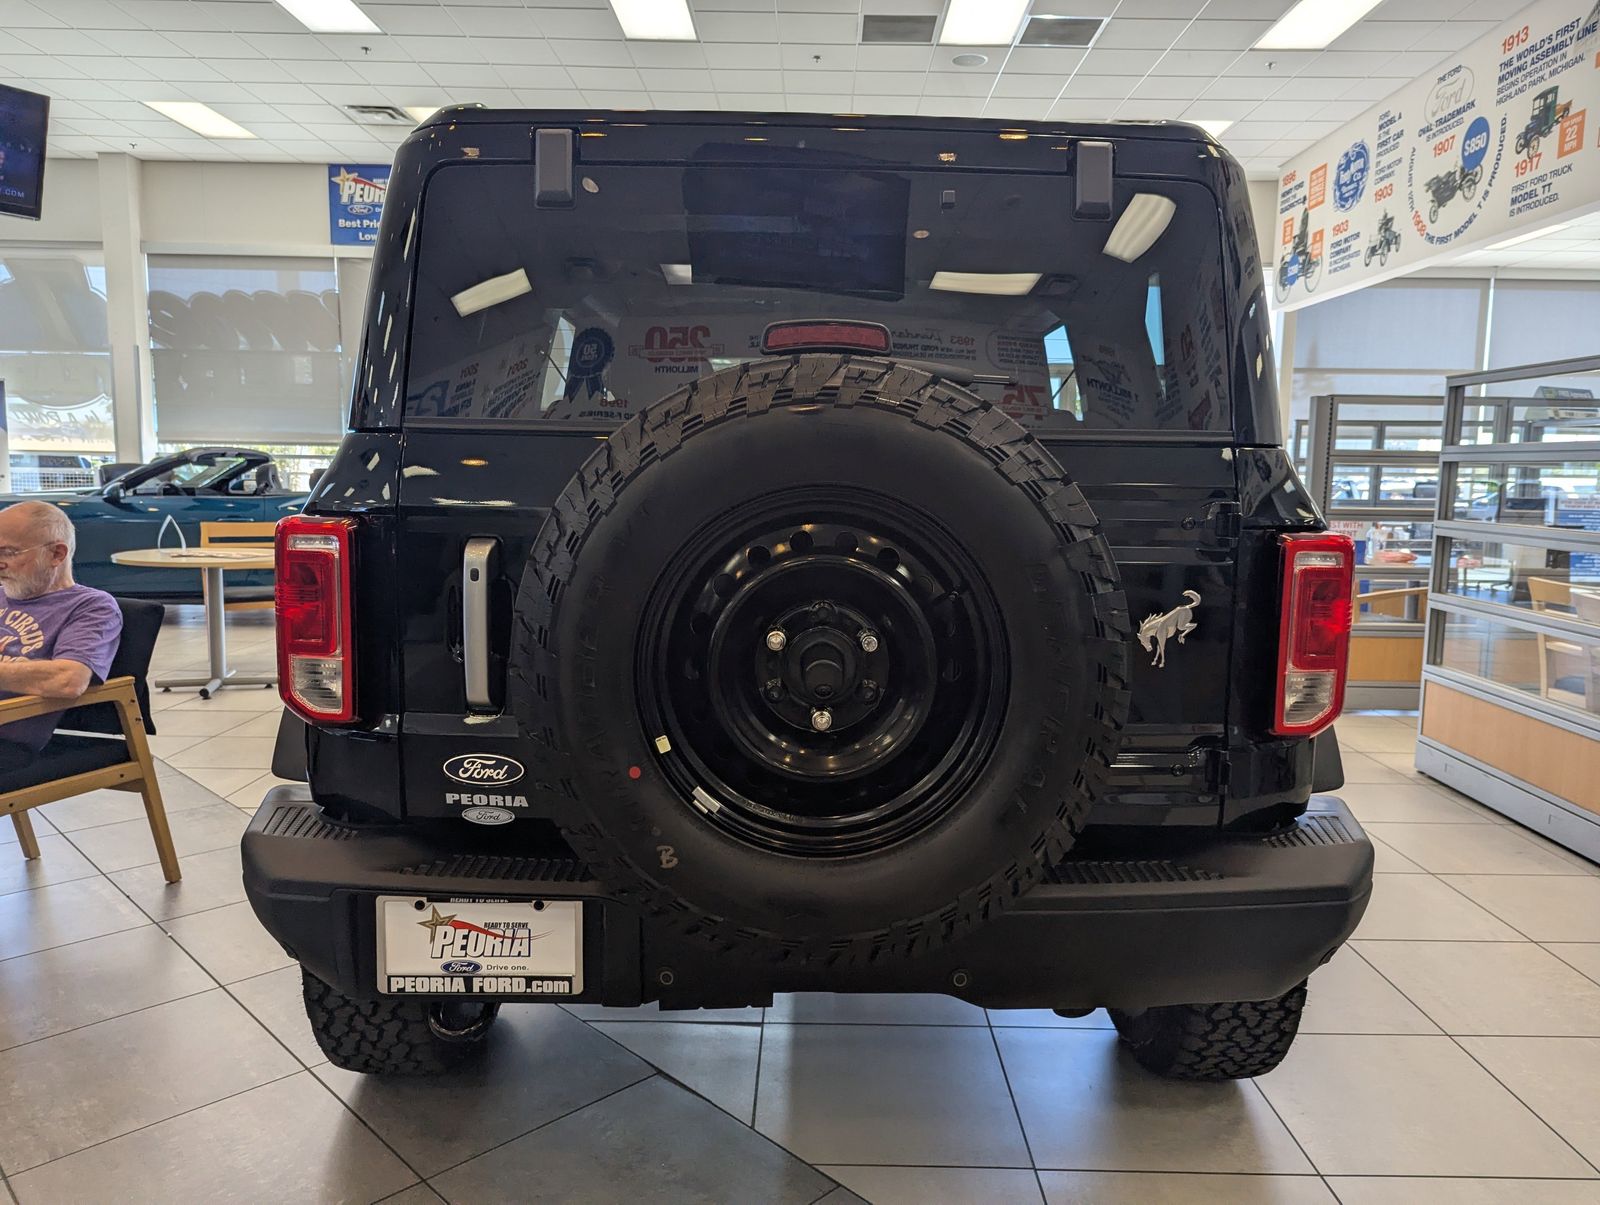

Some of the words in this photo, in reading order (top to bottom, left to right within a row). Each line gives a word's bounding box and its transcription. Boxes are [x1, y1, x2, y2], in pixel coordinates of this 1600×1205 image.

[1499, 56, 1514, 72] THE
[1516, 34, 1553, 63] WORLD'S
[1555, 17, 1581, 41] FIRST
[1502, 25, 1529, 54] 1913
[1497, 61, 1528, 85] MOVING
[1529, 35, 1575, 67] ASSEMBLY
[1576, 20, 1599, 41] LINE
[1437, 72, 1448, 85] THE
[1496, 77, 1519, 96] BEGINS
[1520, 56, 1559, 82] OPERATION
[1559, 52, 1567, 62] IN
[1431, 77, 1467, 118] Ford
[1495, 84, 1527, 107] HIGHLAND
[1378, 115, 1396, 132] MODEL
[1398, 111, 1402, 120] A
[1418, 121, 1433, 138] OVAL
[1434, 99, 1477, 126] TRADEMARK
[1377, 136, 1391, 151] FIRST
[1392, 129, 1404, 142] CAR
[1426, 132, 1432, 143] IS
[1566, 125, 1577, 141] 22
[1432, 134, 1456, 158] 1907
[1463, 135, 1487, 157] $850
[1563, 140, 1577, 152] MPH
[1514, 152, 1542, 178] 1917
[1435, 232, 1453, 245] FIRST
[1454, 212, 1477, 239] MODEL
[1477, 200, 1482, 209] T
[1482, 190, 1490, 201] IS
[1488, 113, 1507, 188] PRODUCED.
[1511, 180, 1529, 195] FIRST
[1529, 173, 1548, 187] FORD
[1549, 163, 1573, 179] TRUCK
[1374, 182, 1393, 203] 1903
[1510, 188, 1538, 207] MODEL
[1542, 182, 1553, 195] TT
[338, 219, 361, 228] Best
[1509, 208, 1516, 217] IS
[1332, 219, 1349, 237] 1903
[5, 610, 44, 655] CIRCUS
[445, 793, 529, 807] PEORIA
[431, 925, 531, 959] PEORIA
[390, 977, 466, 993] PEORIA
[472, 977, 570, 993] FORD.com
